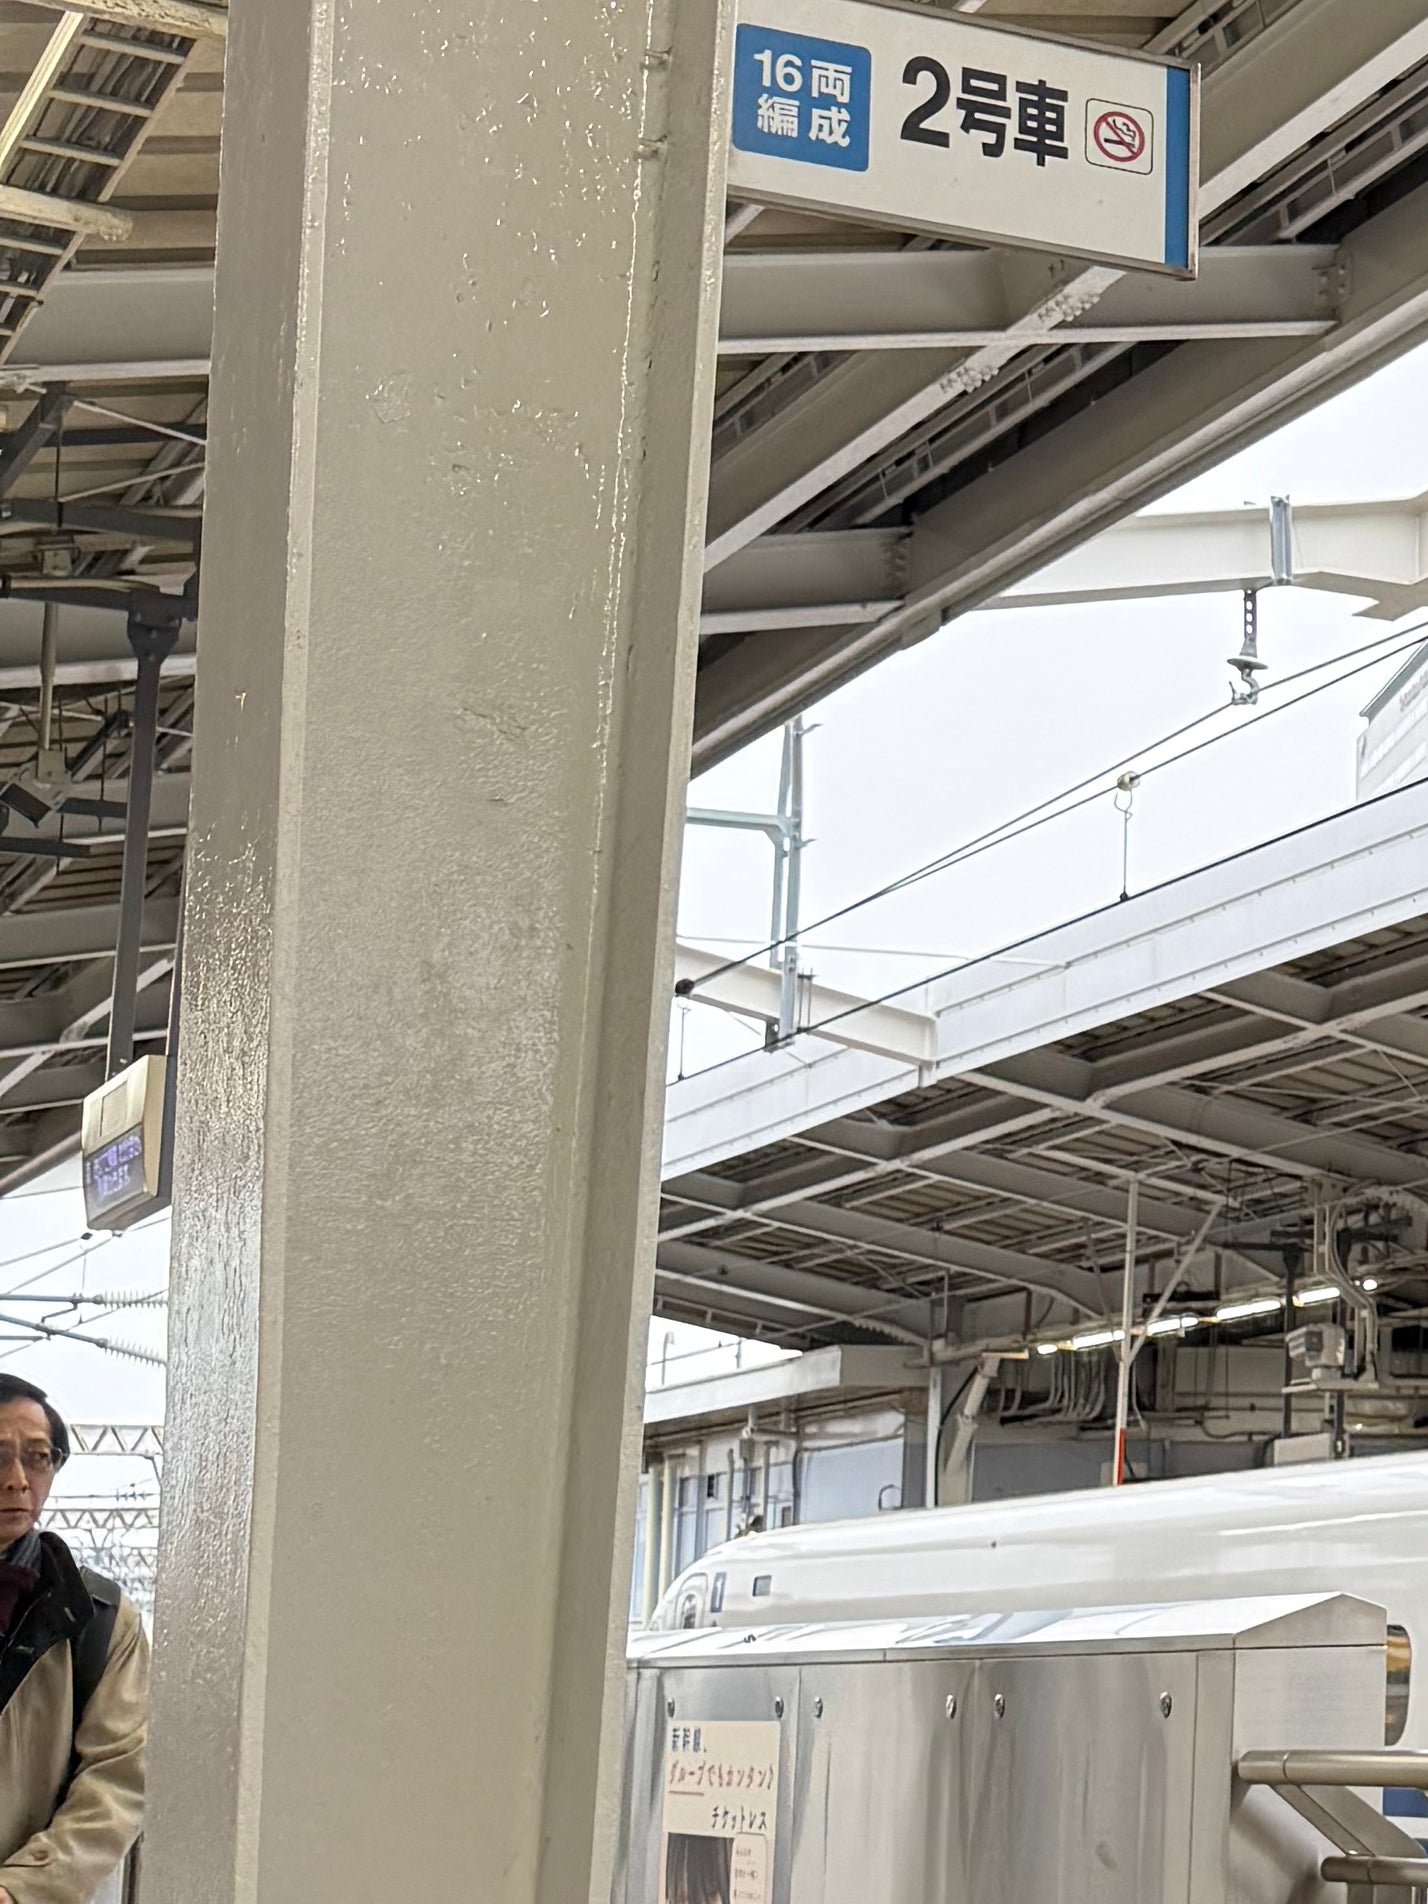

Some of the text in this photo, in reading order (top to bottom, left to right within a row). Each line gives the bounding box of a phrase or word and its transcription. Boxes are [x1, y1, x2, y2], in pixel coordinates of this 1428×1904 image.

[754, 48, 853, 103] 16両
[757, 93, 851, 148] 編成
[900, 55, 1069, 167] 2号車
[711, 1805, 767, 1833] チケットレス
